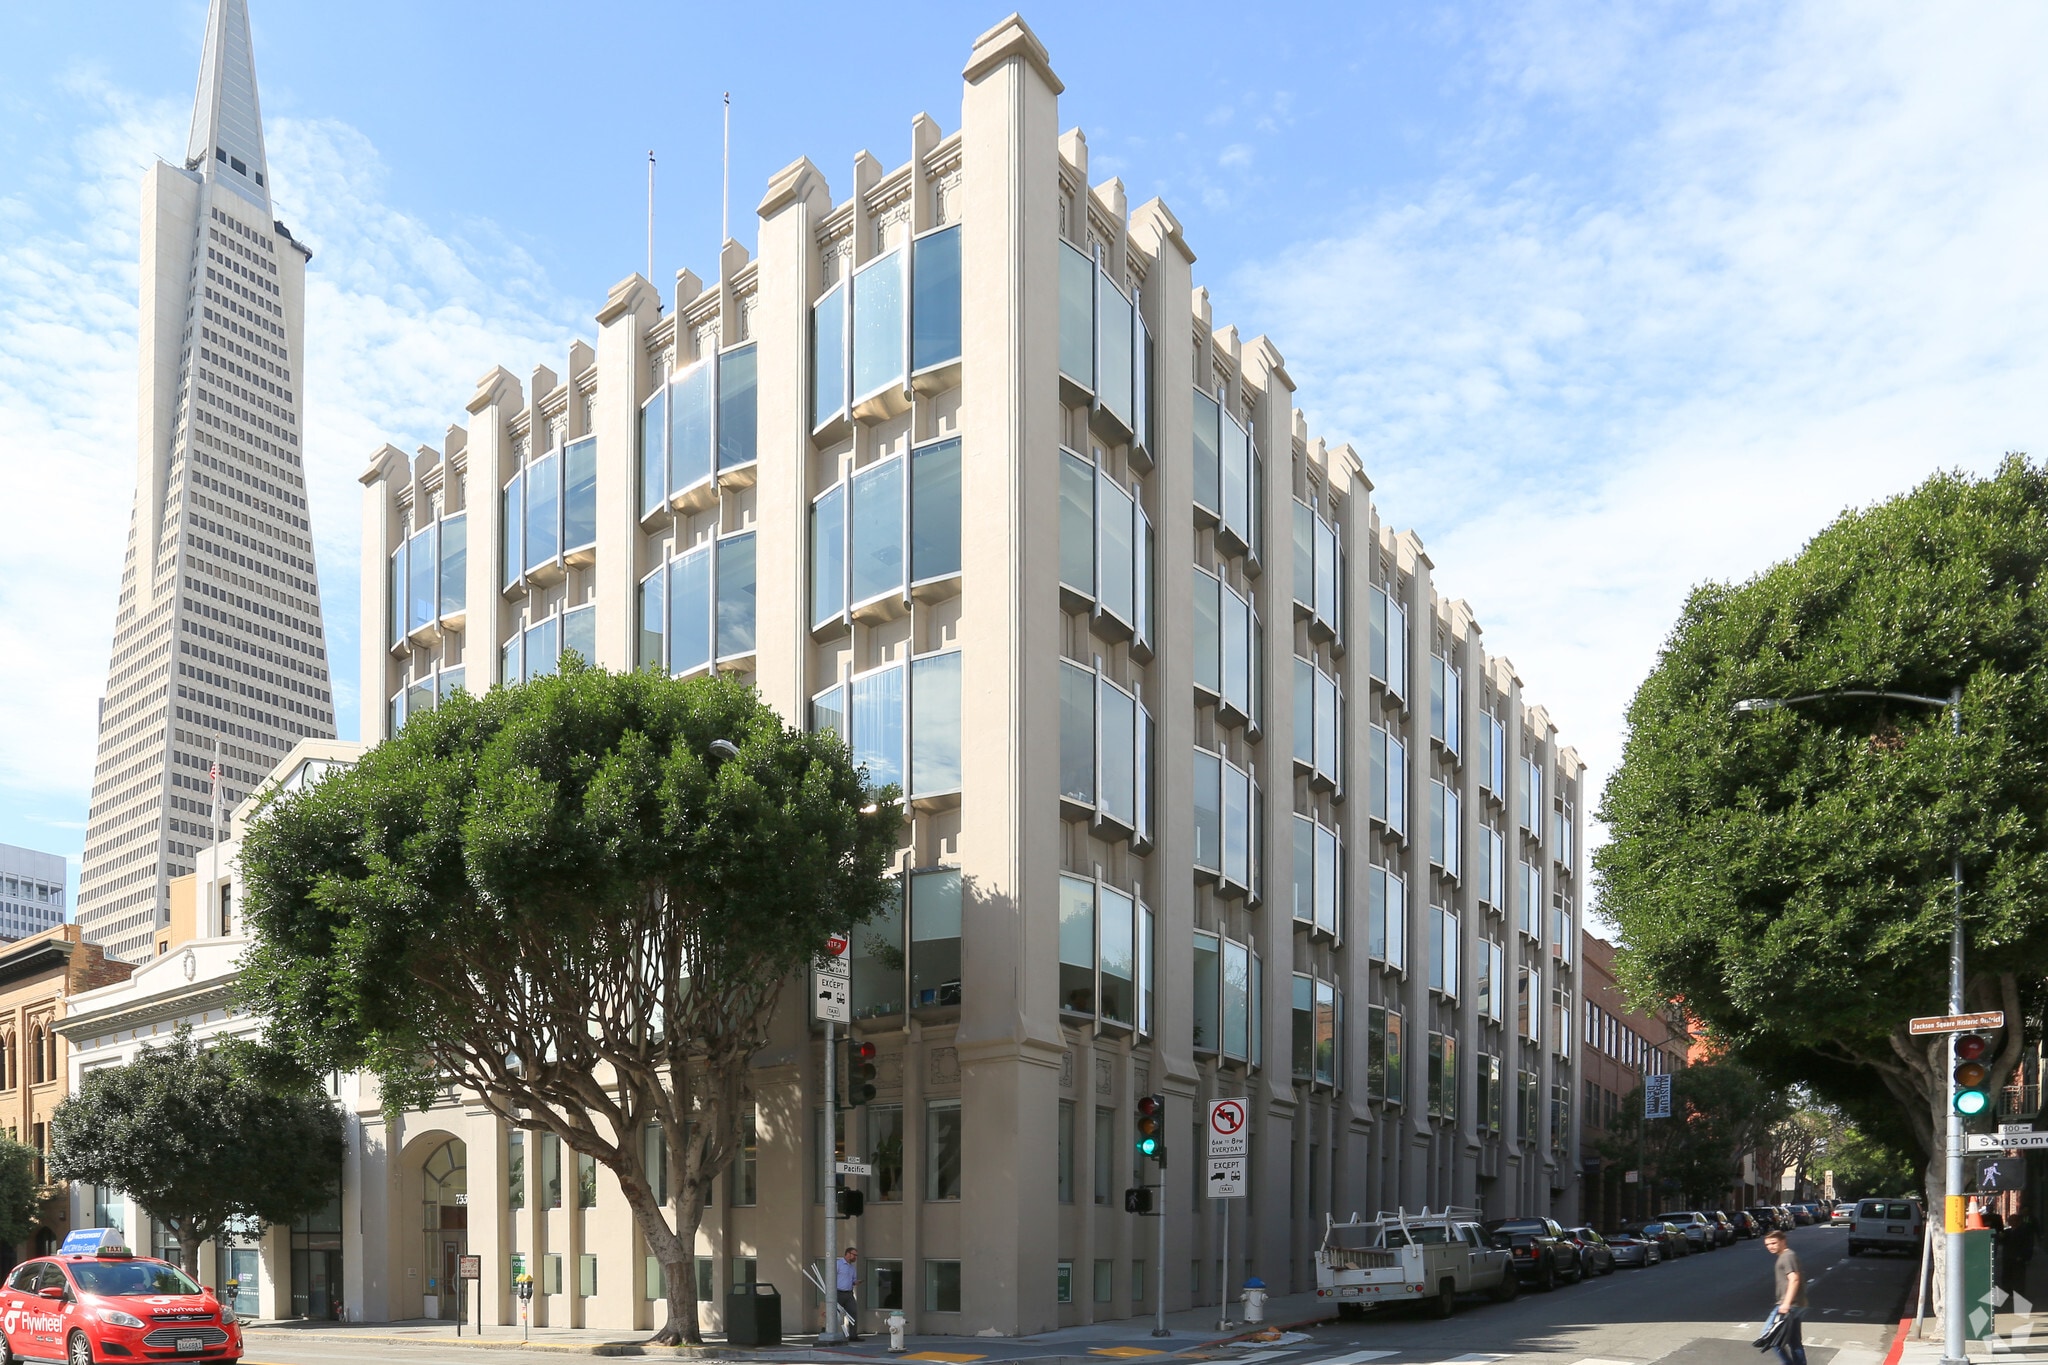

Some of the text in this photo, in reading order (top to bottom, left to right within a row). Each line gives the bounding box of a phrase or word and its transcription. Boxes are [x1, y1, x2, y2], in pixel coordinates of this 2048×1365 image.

[821, 979, 844, 990] EXCEPT
[1936, 1021, 1955, 1029] Square
[1980, 1016, 2001, 1024] District
[1647, 1085, 1656, 1114] DESIGN
[1660, 1076, 1670, 1113] MUSEUM
[843, 1164, 865, 1173] Pacific
[1213, 1161, 1240, 1169] EXCEPT
[152, 1306, 205, 1314] Flywheel
[21, 1311, 63, 1335] Flywheel
